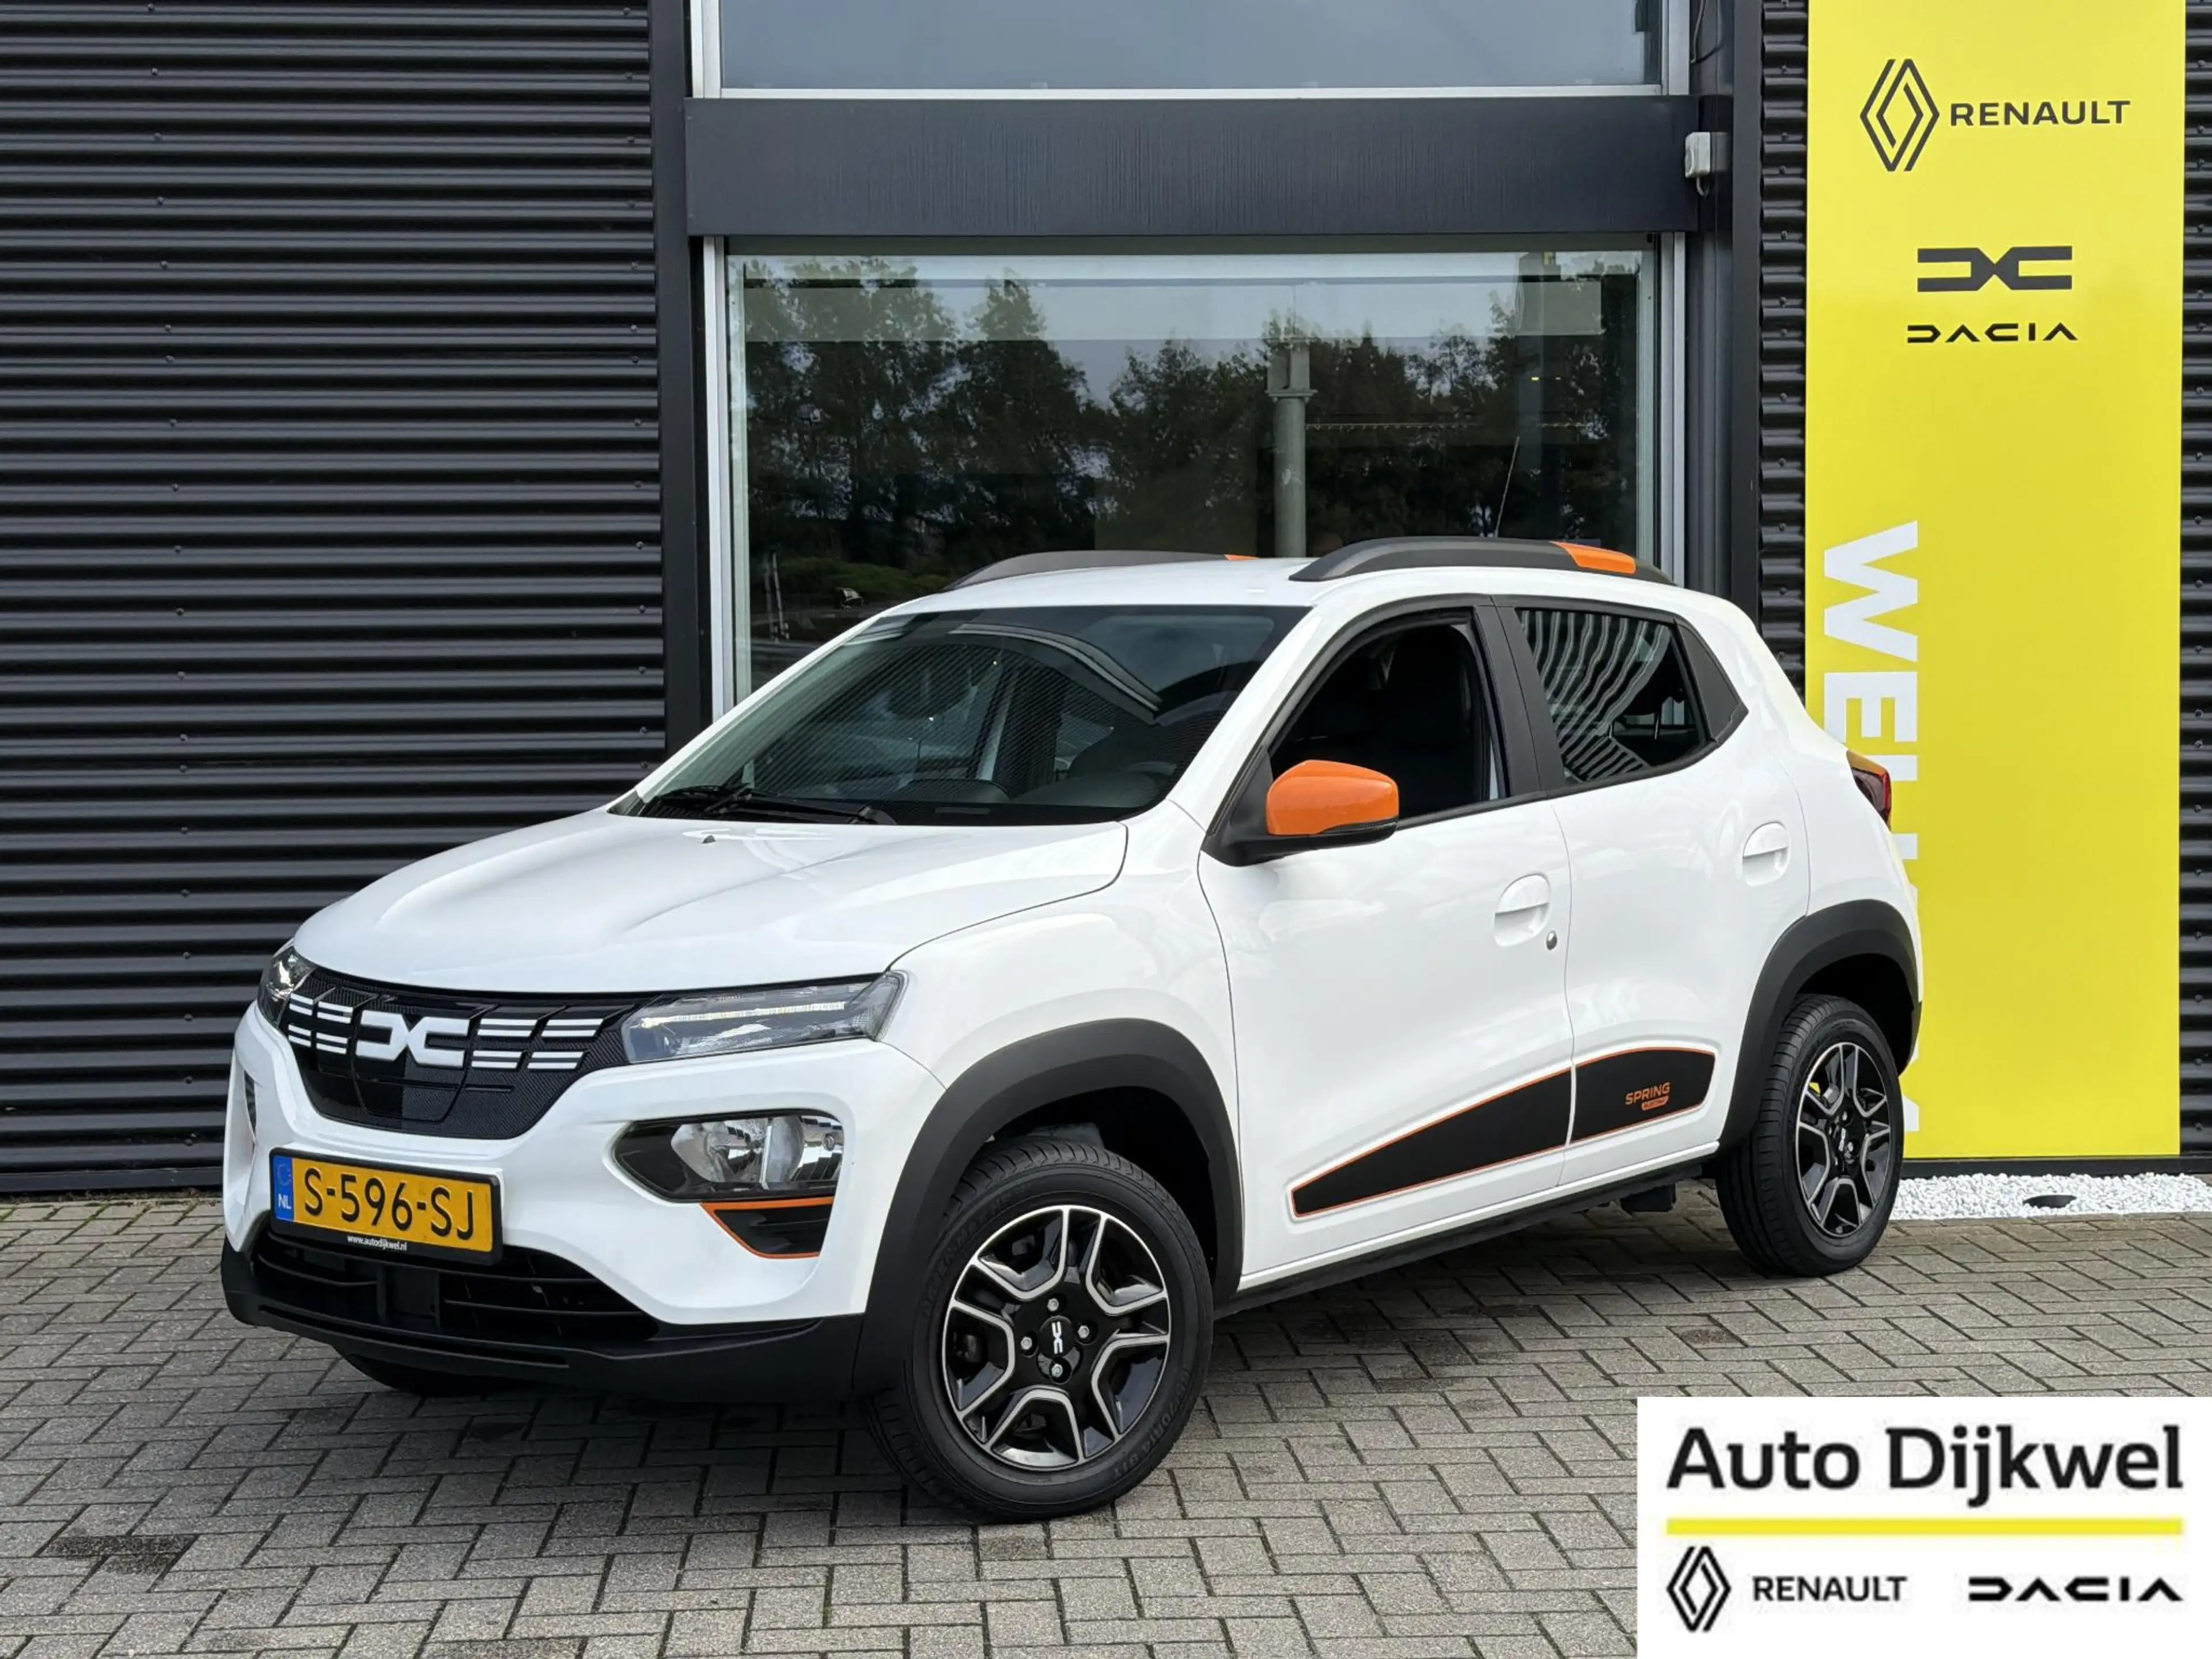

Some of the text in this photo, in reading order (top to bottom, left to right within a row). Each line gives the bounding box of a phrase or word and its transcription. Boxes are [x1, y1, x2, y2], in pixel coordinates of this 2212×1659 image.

[1950, 100, 2131, 126] RENAULT
[1907, 323, 2078, 343] DACIA
[1625, 1082, 1671, 1105] SPRING
[278, 1194, 292, 1210] NL
[304, 1168, 474, 1240] S-596-SJ
[347, 1236, 407, 1251] www.autodijkwel.nl
